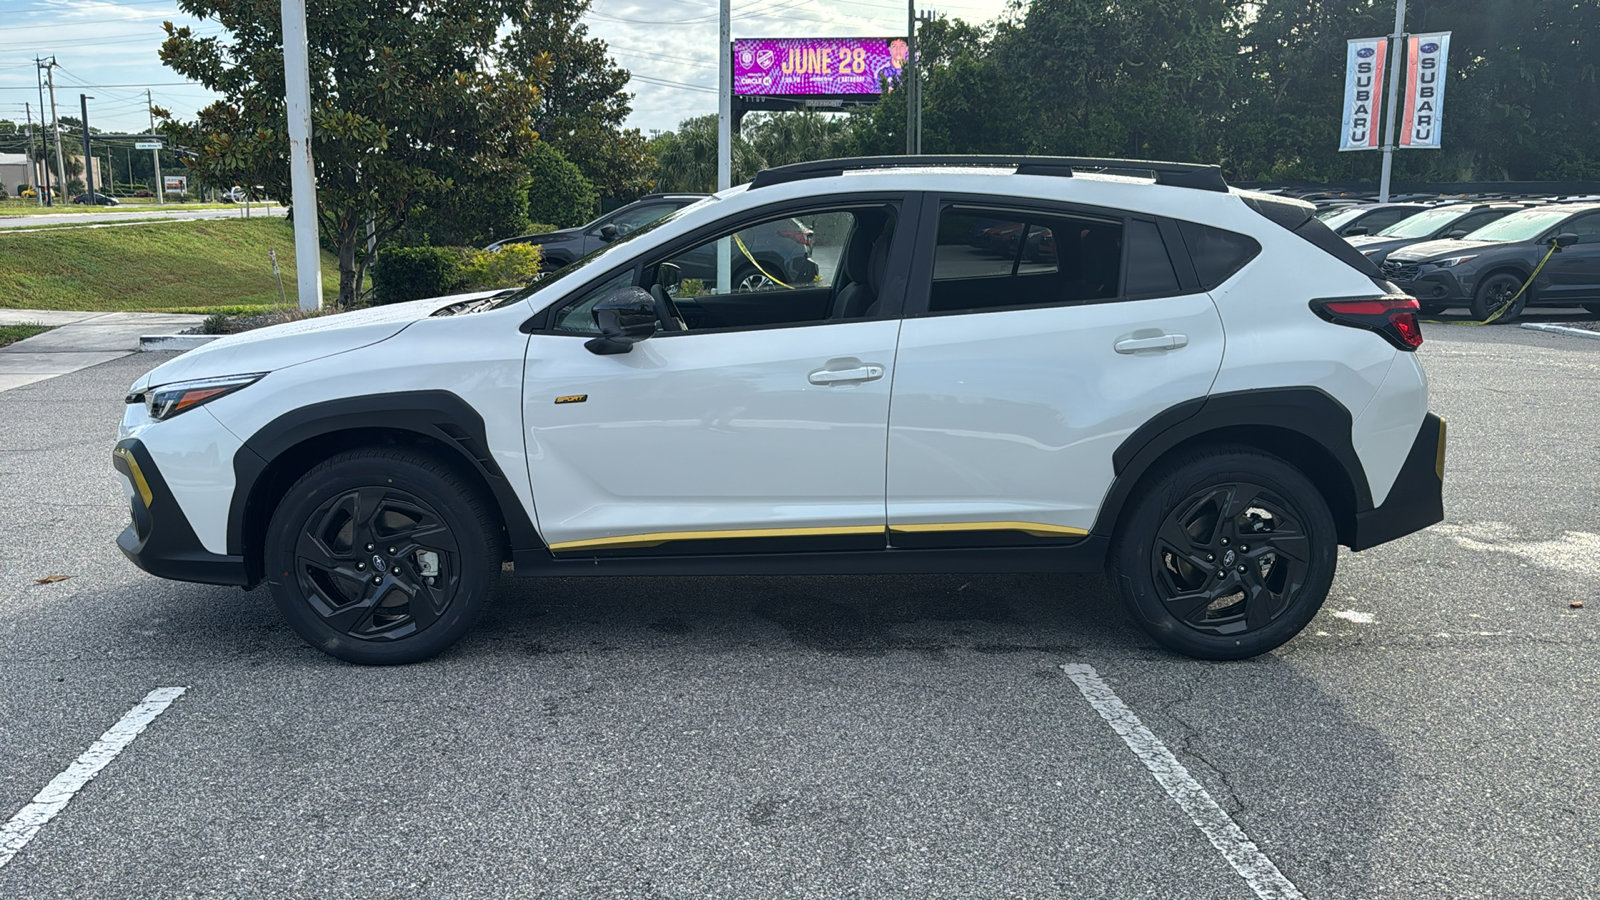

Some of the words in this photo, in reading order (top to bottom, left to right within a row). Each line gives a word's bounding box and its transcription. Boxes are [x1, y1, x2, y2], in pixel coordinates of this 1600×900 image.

[782, 48, 832, 74] JUNE
[839, 48, 866, 74] 28
[1352, 62, 1372, 142] SUBARU
[1415, 58, 1436, 140] SUBARU
[556, 395, 585, 403] SPORT
